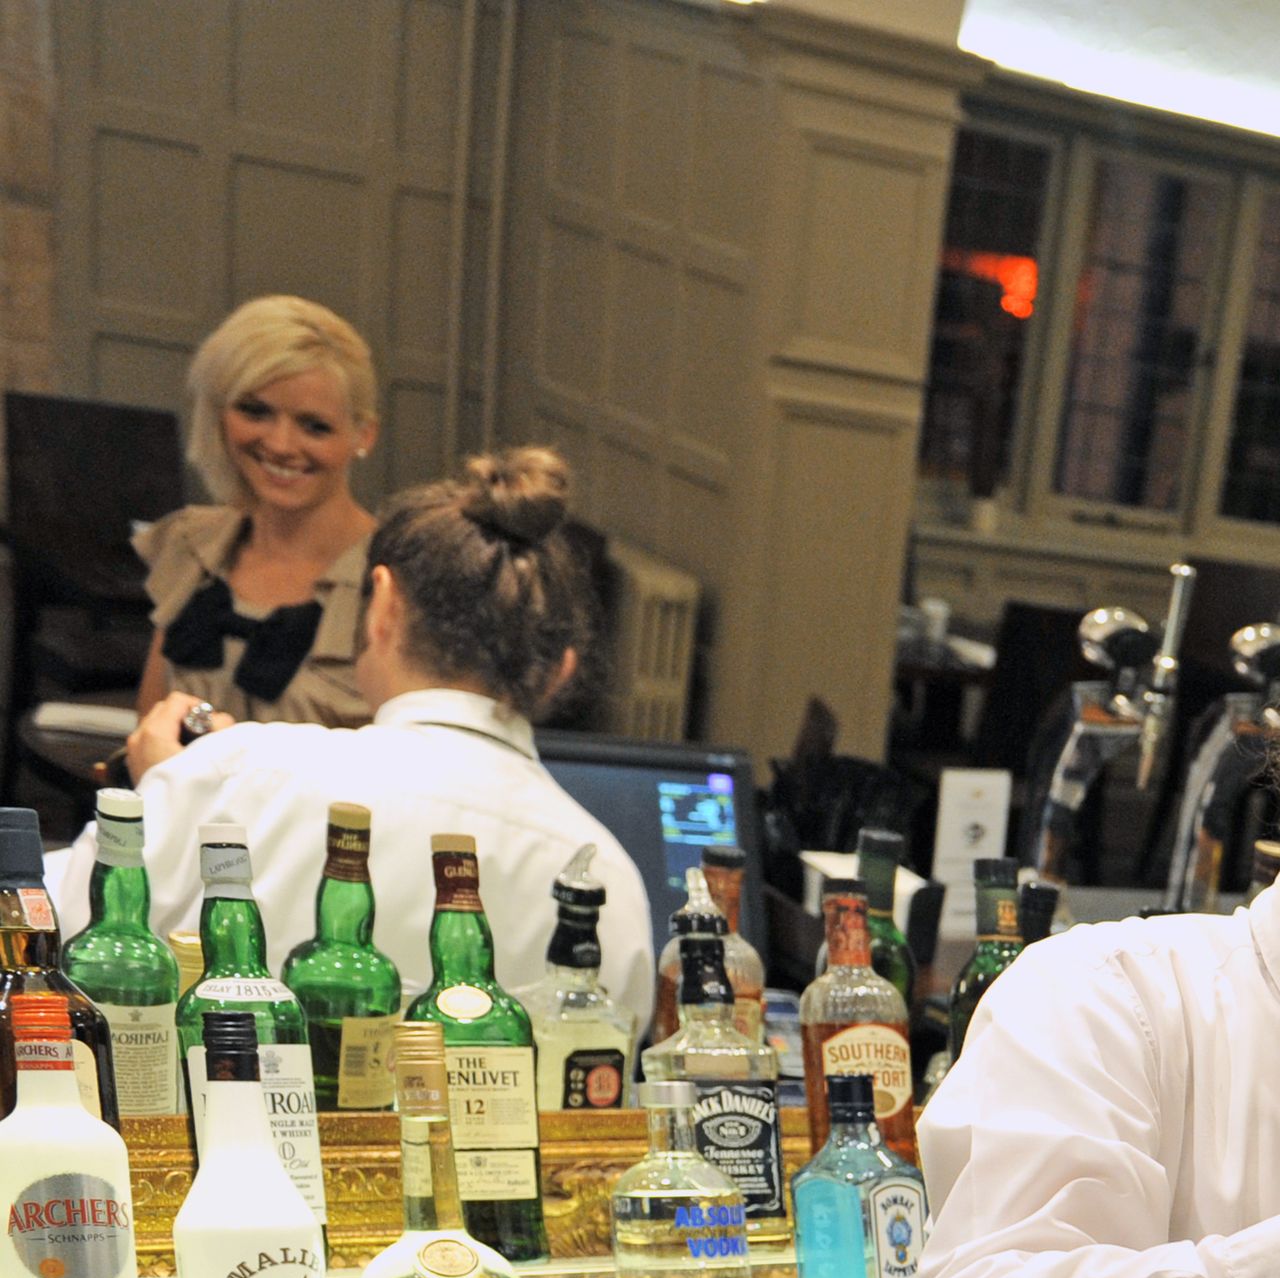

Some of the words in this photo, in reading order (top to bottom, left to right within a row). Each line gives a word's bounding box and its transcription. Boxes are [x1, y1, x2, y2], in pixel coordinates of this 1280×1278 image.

[235, 983, 272, 998] 1815
[828, 1042, 908, 1064] SOUTHERN
[456, 1057, 486, 1069] THE
[447, 1071, 520, 1088] ENLIVET
[465, 1099, 486, 1115] 12
[269, 1119, 298, 1129] NGLE
[8, 1198, 130, 1234] ARCHERS
[48, 1233, 106, 1244] SCHNAPPS
